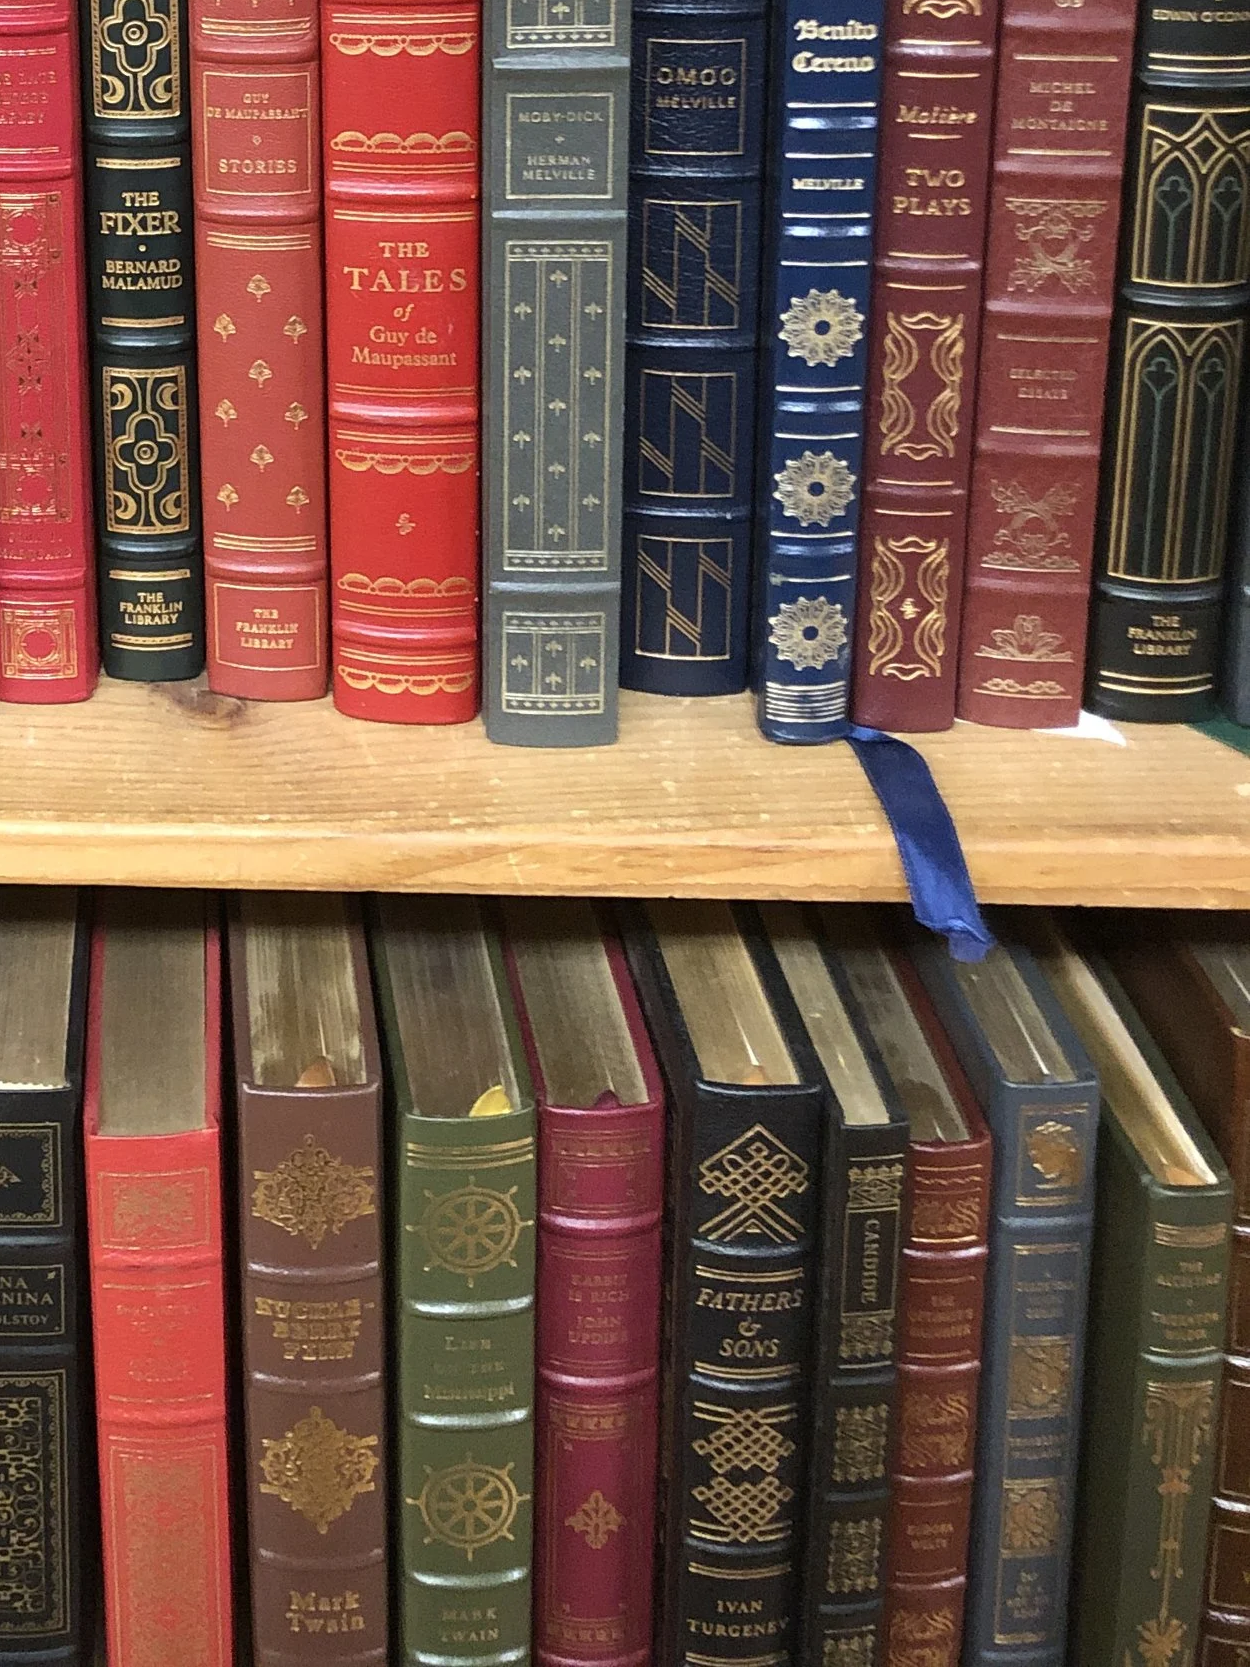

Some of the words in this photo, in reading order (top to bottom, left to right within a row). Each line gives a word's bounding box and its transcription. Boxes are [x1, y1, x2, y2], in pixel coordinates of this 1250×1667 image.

[243, 93, 270, 104] GUY
[206, 107, 222, 118] DE
[218, 159, 297, 174] STORIES
[527, 155, 592, 166] HERMAN
[522, 169, 595, 181] MELVILLE
[905, 169, 965, 188] TWO
[121, 191, 160, 207] THE
[892, 196, 972, 216] PLAYS
[100, 211, 182, 235] FIXER
[378, 241, 430, 258] THE
[105, 259, 181, 274] BERNARD
[102, 275, 182, 291] MALAMUD
[343, 266, 467, 293] TALES
[393, 304, 414, 322] of
[369, 326, 409, 348] Guy
[415, 326, 437, 344] de
[351, 346, 457, 369] Maupassant
[137, 592, 164, 603] THE
[119, 600, 183, 615] FRANKLIN
[253, 609, 279, 619] THE
[124, 612, 178, 626] LIBRARY
[1151, 615, 1181, 628] THE
[240, 637, 293, 650] LIBRARY
[861, 1218, 880, 1305] CANDIDE
[695, 1287, 804, 1311] FATHERS
[738, 1317, 761, 1336] &
[718, 1339, 779, 1359] SONS
[716, 1599, 763, 1613] IVAN
[686, 1617, 790, 1638] TURGENEV
